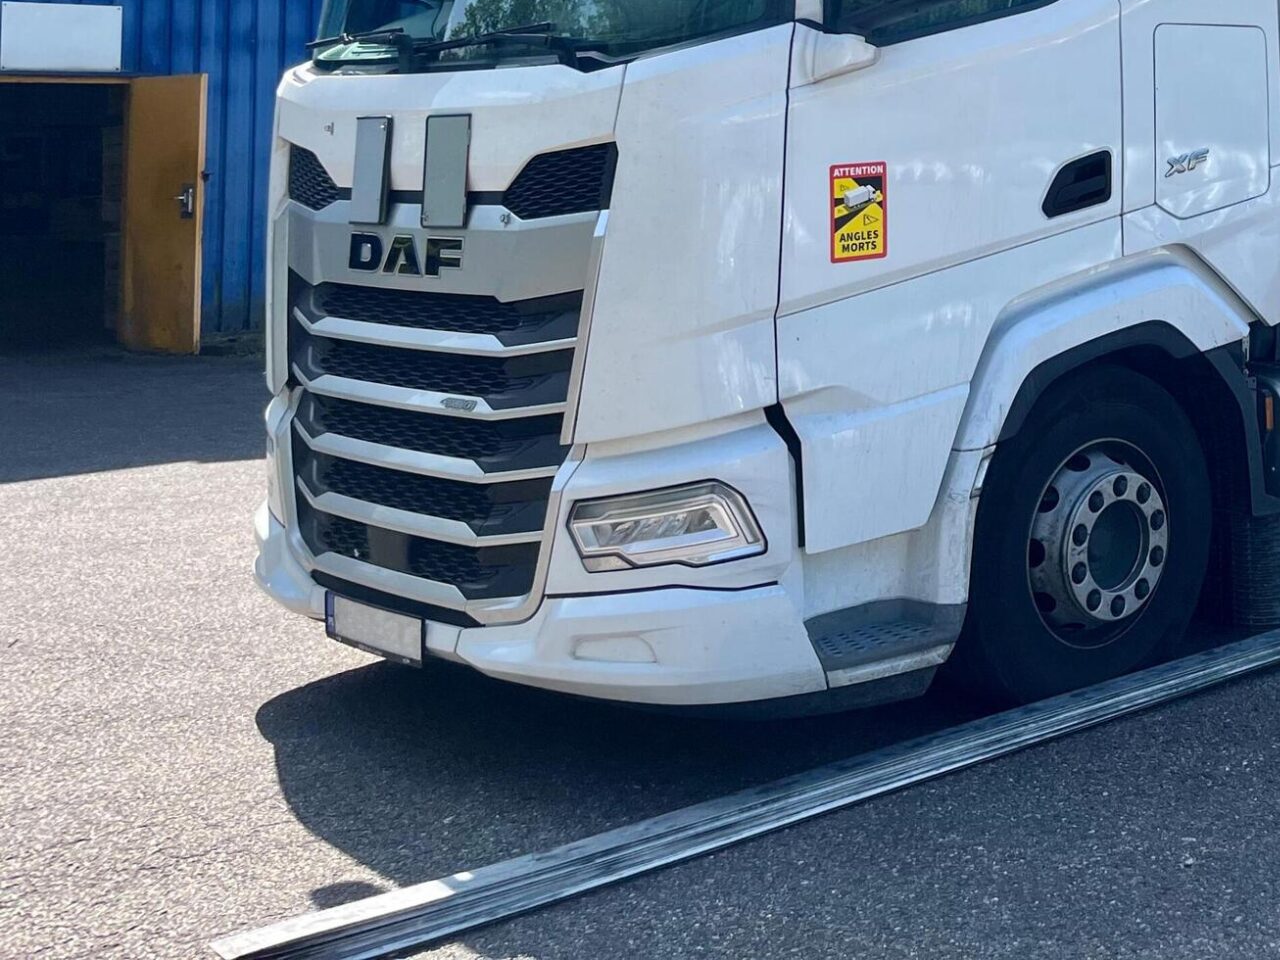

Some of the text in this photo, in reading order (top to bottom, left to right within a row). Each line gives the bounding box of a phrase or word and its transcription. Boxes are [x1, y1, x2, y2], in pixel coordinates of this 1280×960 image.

[1165, 147, 1209, 178] XF
[833, 165, 884, 177] ATTENTION
[839, 230, 879, 242] ANGLES
[842, 240, 877, 253] MORTS
[348, 230, 465, 279] DAF
